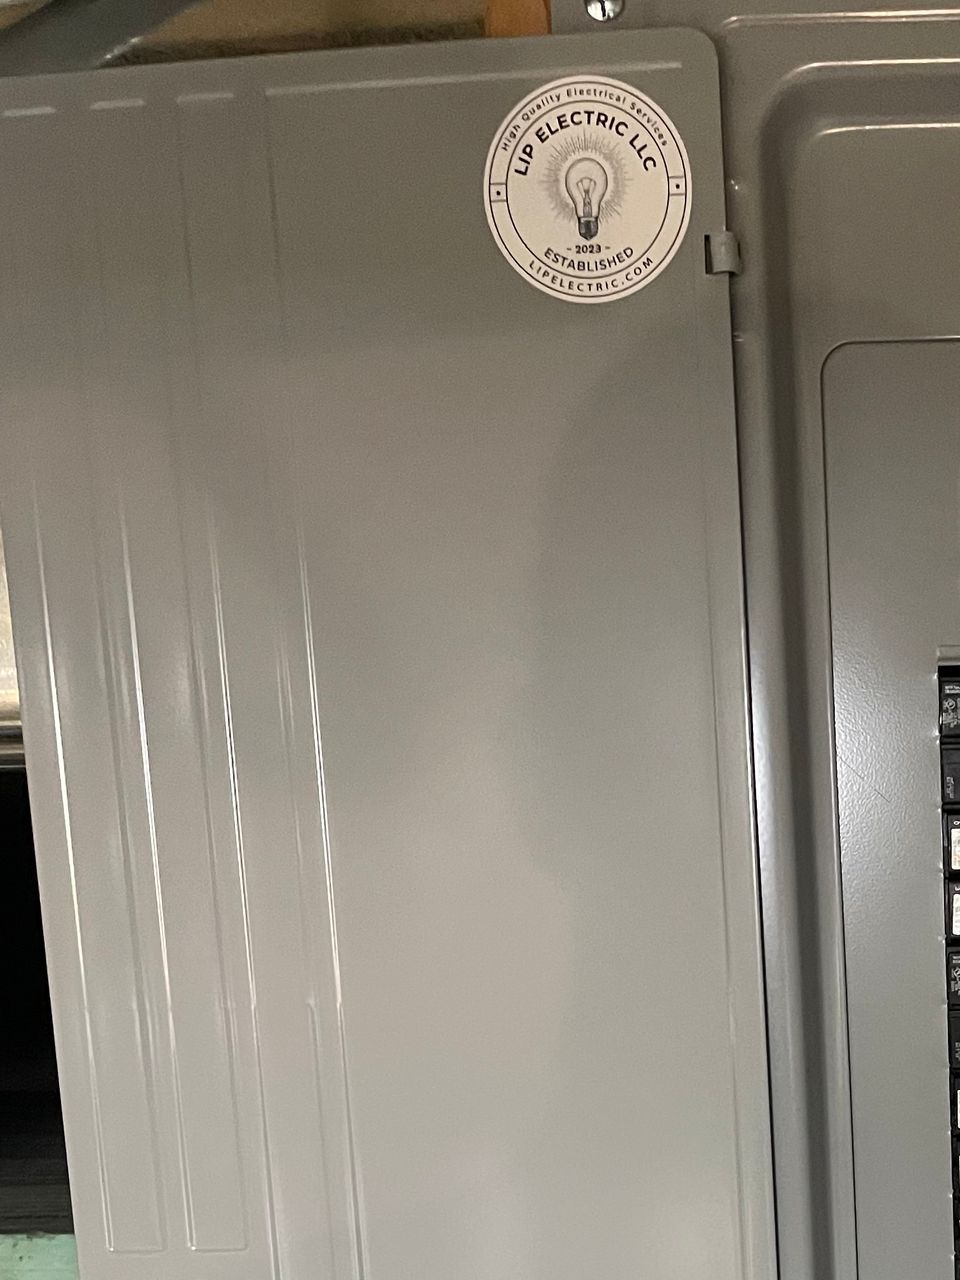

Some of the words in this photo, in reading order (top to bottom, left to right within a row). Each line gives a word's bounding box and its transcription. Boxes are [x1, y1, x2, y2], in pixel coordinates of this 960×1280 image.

[502, 125, 521, 152] High
[522, 94, 562, 122] Quality
[566, 88, 626, 104] Electrical
[630, 102, 669, 147] Services
[515, 144, 534, 176] LIP
[536, 111, 629, 144] ELECTRIC
[629, 134, 657, 172] LLC
[544, 246, 634, 272] ESTABLISHED
[575, 245, 602, 254] 2023
[529, 257, 654, 292] LIPELECTRIC.COM
